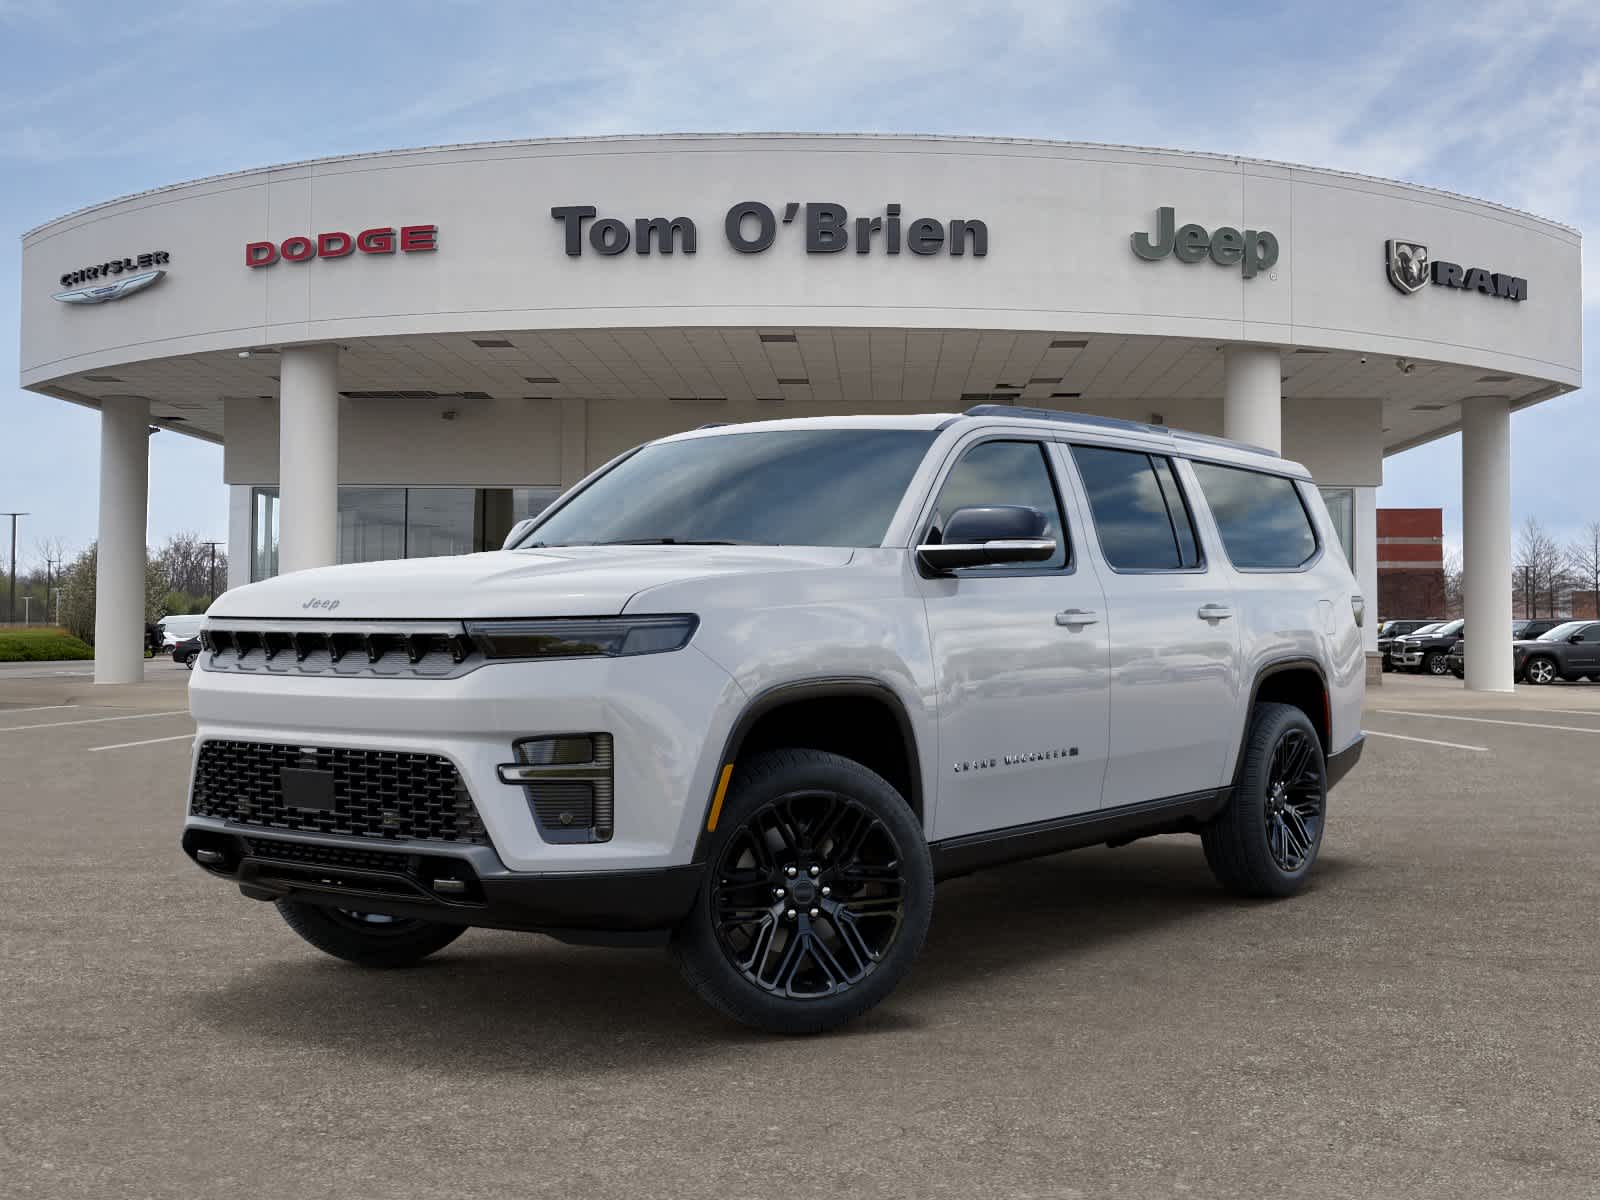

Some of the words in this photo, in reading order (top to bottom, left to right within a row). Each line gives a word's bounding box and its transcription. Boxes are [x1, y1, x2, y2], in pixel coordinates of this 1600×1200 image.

[245, 224, 438, 269] DODGE
[551, 205, 697, 257] Tom
[724, 201, 988, 256] O'Brien
[1130, 206, 1279, 279] Jeep
[60, 249, 171, 288] CHRYSLER
[1430, 260, 1528, 302] RAM
[301, 597, 341, 611] Jeep
